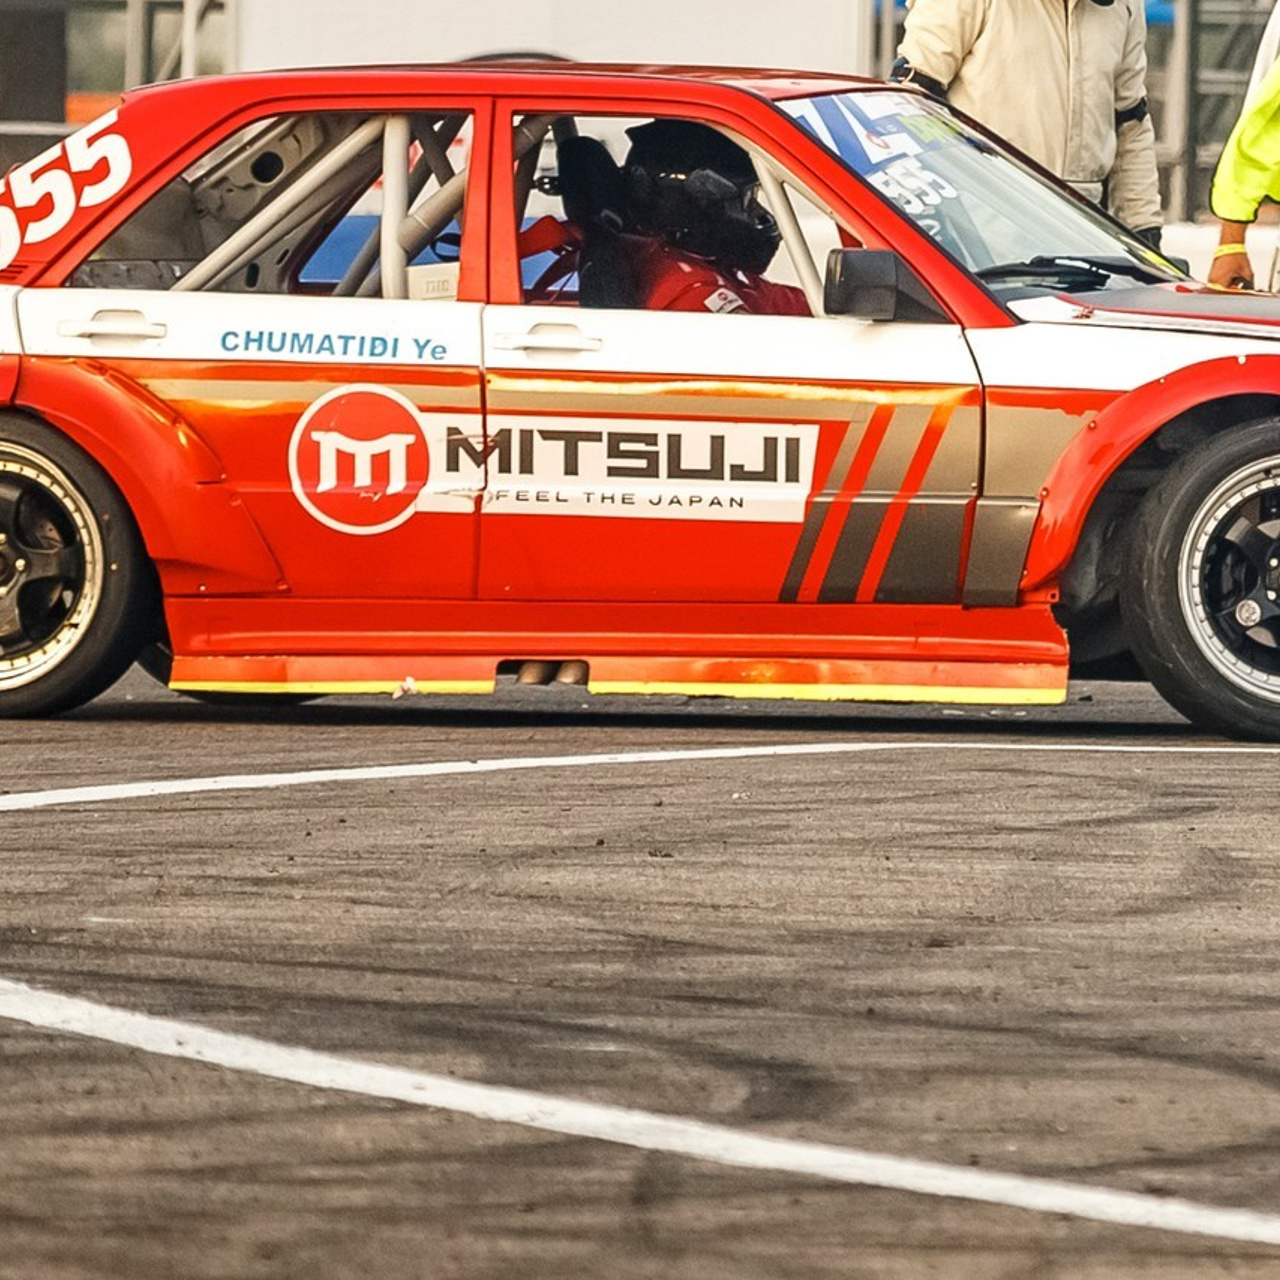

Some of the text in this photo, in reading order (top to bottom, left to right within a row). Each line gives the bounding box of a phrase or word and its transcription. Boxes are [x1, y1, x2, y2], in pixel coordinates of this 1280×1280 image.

[221, 331, 447, 360] CHUMATIDI Ye
[446, 427, 800, 483] MITSUJI
[496, 490, 744, 508] FEEL THE JAPAN
